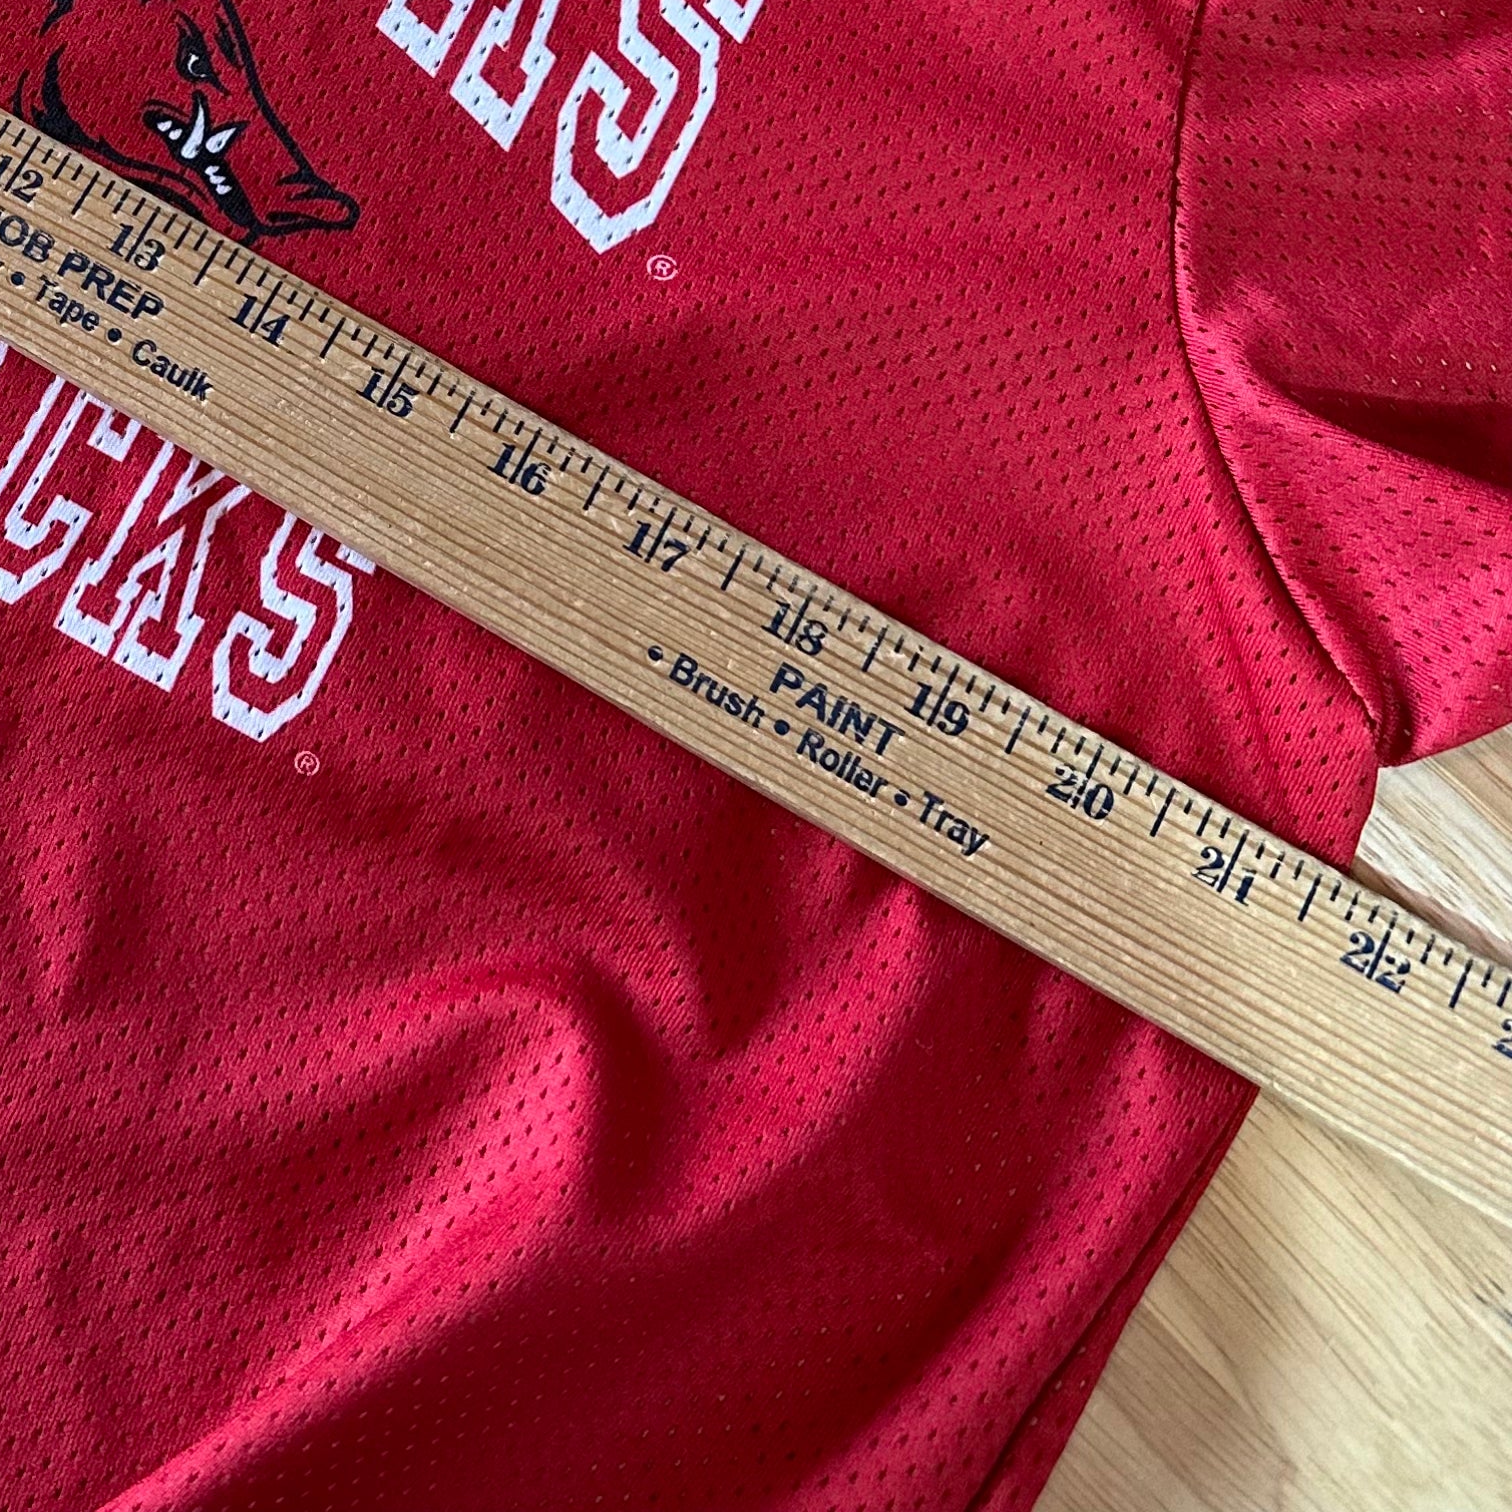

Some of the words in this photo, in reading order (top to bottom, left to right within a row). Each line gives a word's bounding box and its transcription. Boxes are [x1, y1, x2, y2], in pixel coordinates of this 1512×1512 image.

[35, 275, 101, 334] Tape
[131, 340, 214, 403] Caulk
[56, 252, 164, 322] PREP
[109, 224, 166, 272] 13
[231, 294, 290, 348] 14
[356, 366, 418, 419] 15
[487, 441, 549, 497] 16
[622, 520, 688, 572] 17
[761, 599, 827, 656] 18
[903, 681, 969, 736] 19
[1045, 763, 1115, 822] 20
[1191, 845, 1257, 907] 21
[1339, 930, 1412, 994] 22
[668, 653, 765, 729] Brush
[795, 727, 888, 799] Roller
[917, 791, 991, 859] Tray
[769, 662, 904, 758] PAINT
